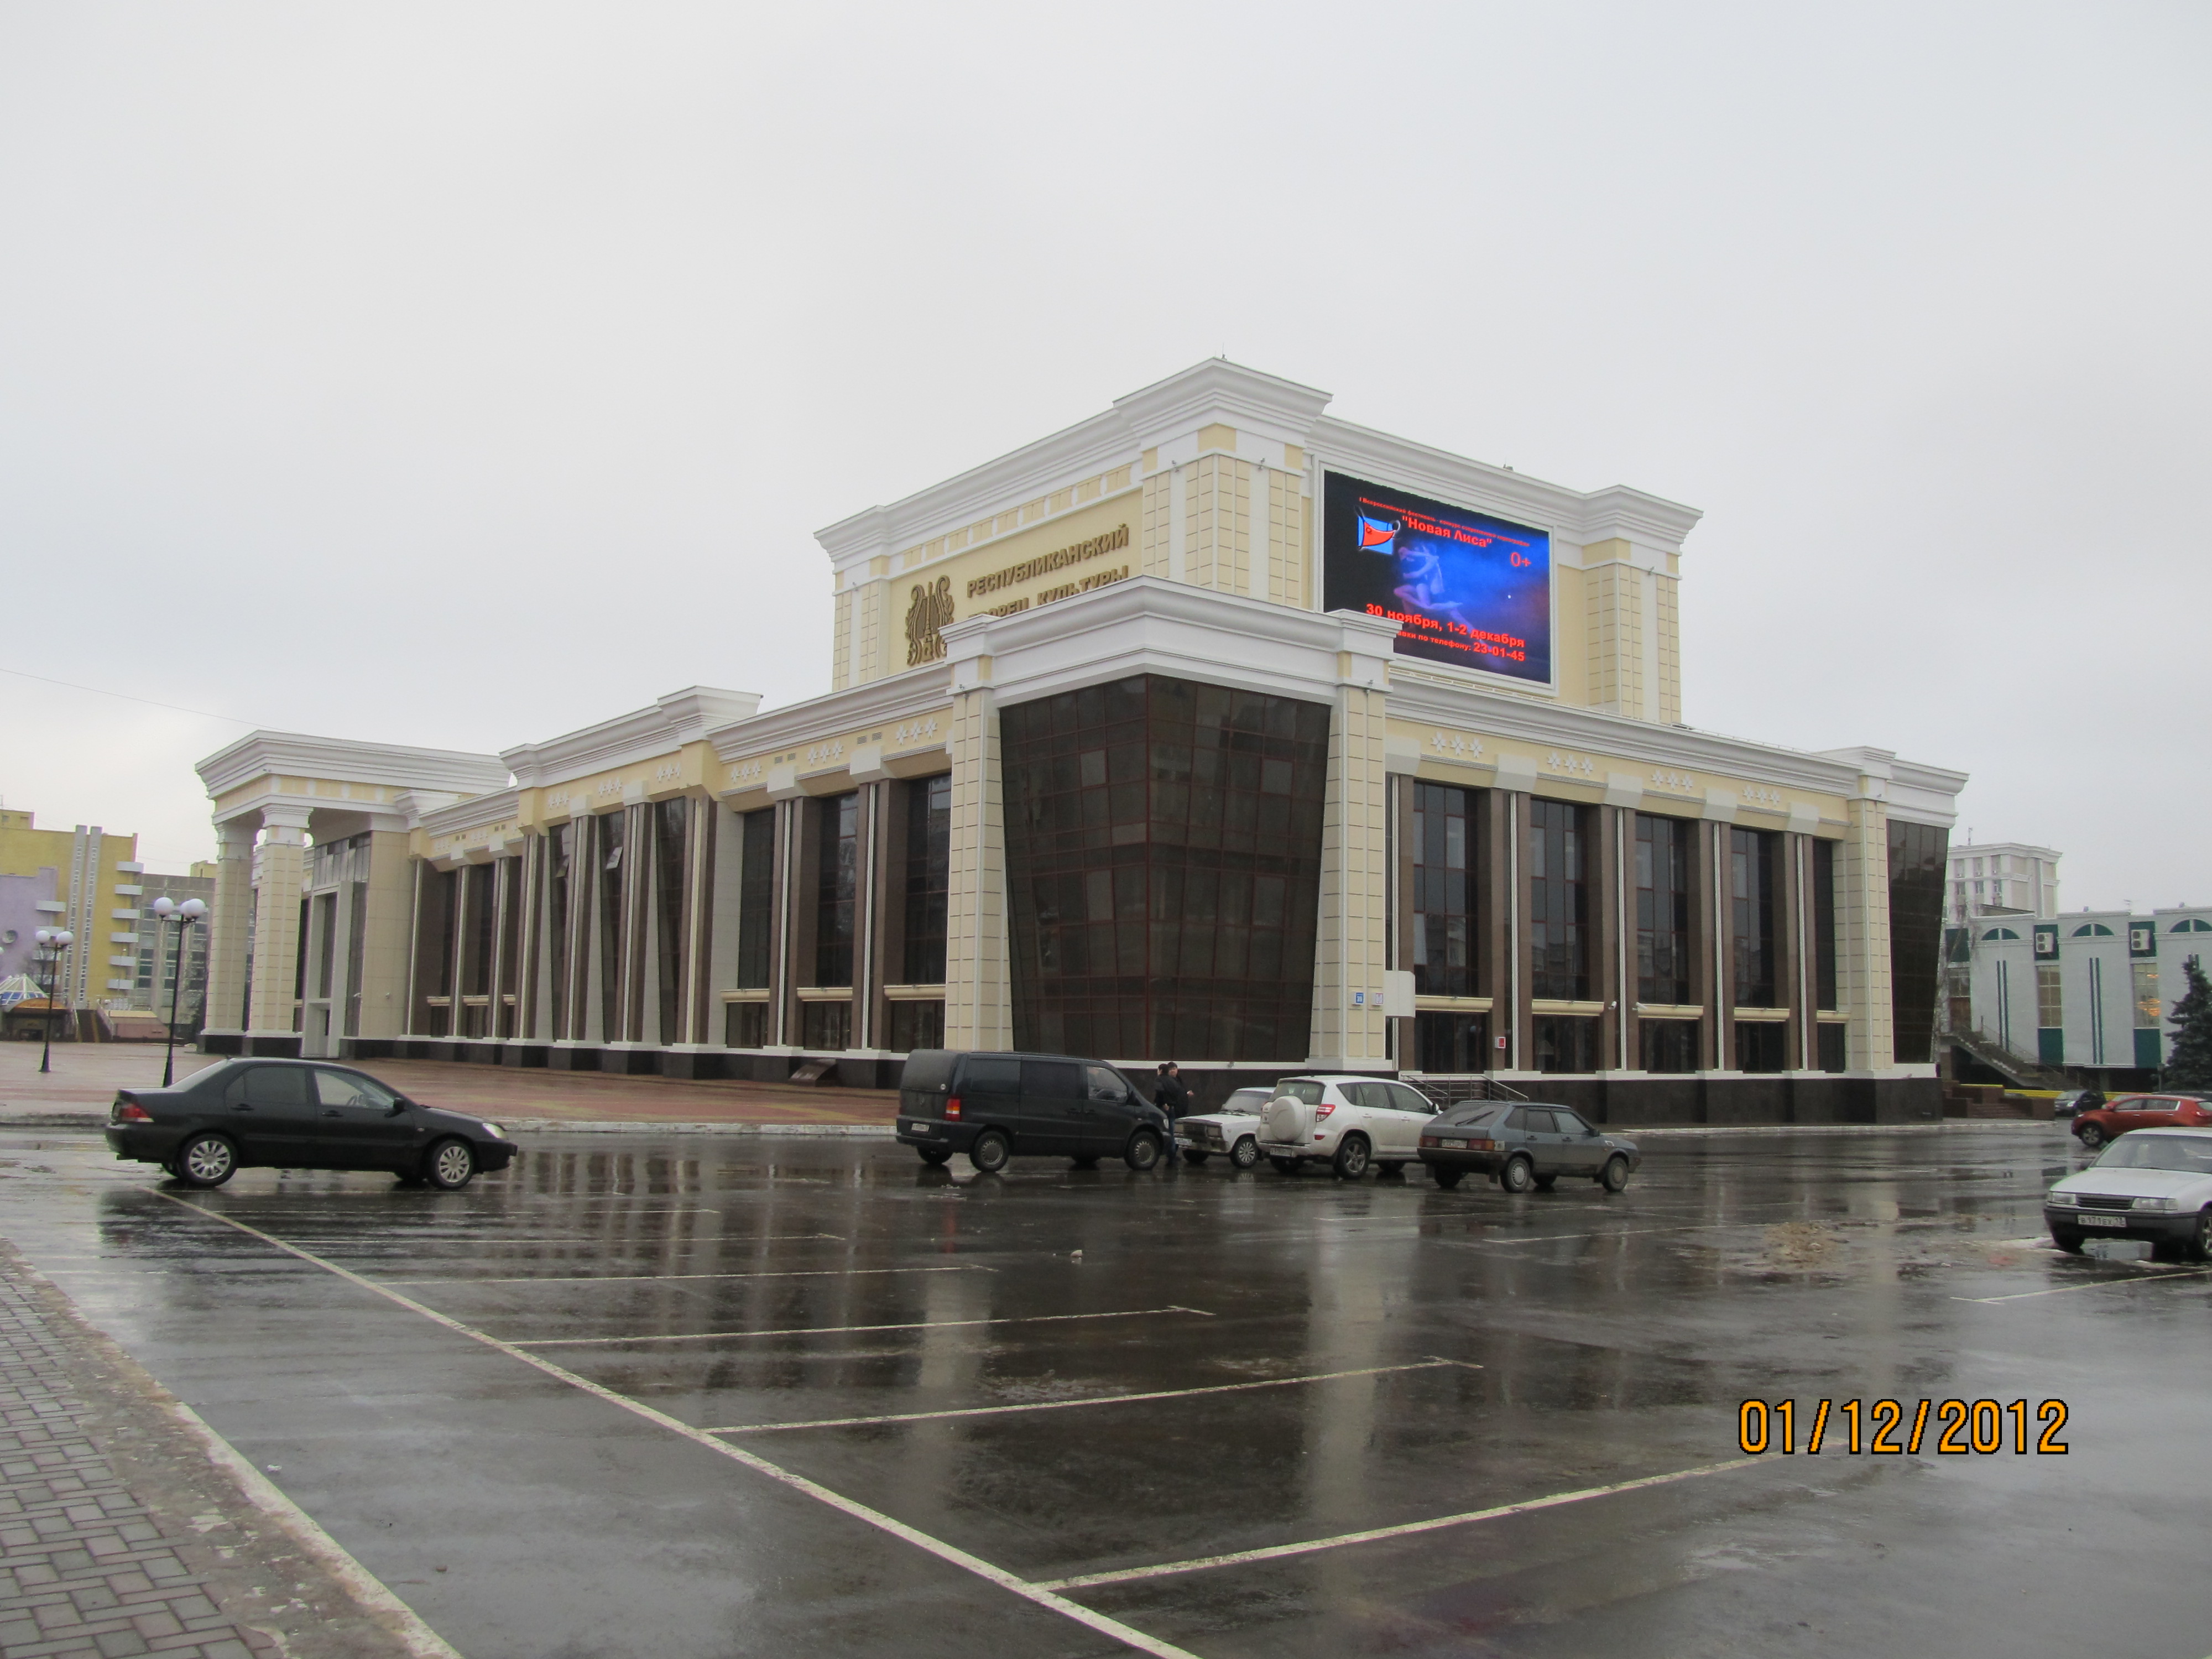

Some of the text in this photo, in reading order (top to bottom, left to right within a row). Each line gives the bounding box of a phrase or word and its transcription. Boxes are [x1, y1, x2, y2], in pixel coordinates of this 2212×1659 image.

[1402, 515, 1451, 538] "Новая
[1454, 530, 1493, 547] Лиса"
[967, 523, 1129, 598] РЕСПУБЛИКАНСКИЙ
[1510, 552, 1531, 567] 0+
[1366, 603, 1526, 648] 30 ноября, 1-2 декабря
[1430, 637, 1471, 651] телефону:
[1473, 641, 1526, 662] 23-01-45
